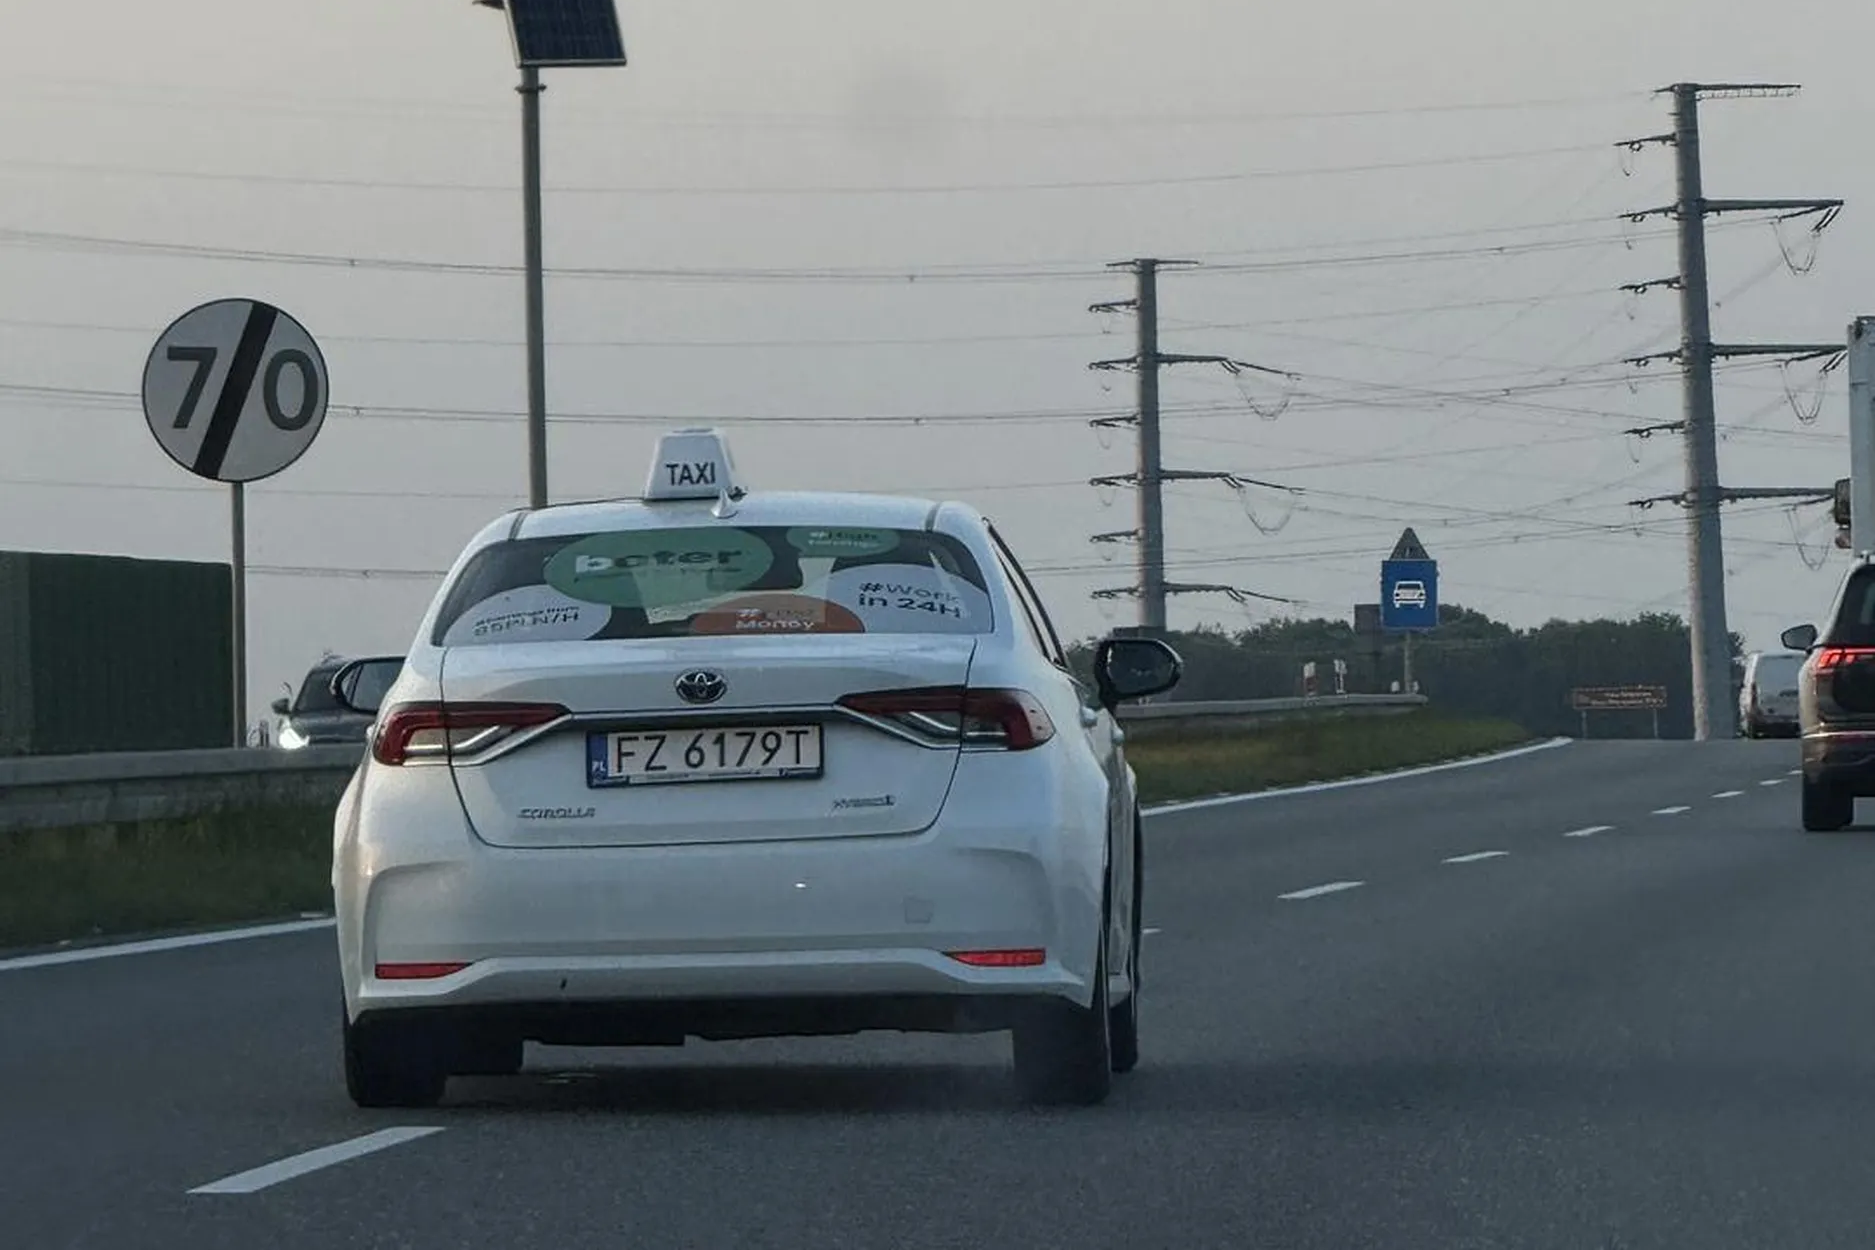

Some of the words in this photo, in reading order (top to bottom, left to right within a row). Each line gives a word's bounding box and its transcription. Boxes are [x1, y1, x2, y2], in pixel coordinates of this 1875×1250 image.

[167, 346, 318, 431] 70
[665, 461, 716, 486] TAXI
[859, 593, 888, 607] in
[897, 597, 961, 618] 24H
[616, 735, 668, 773] FZ
[684, 729, 809, 769] 6179T
